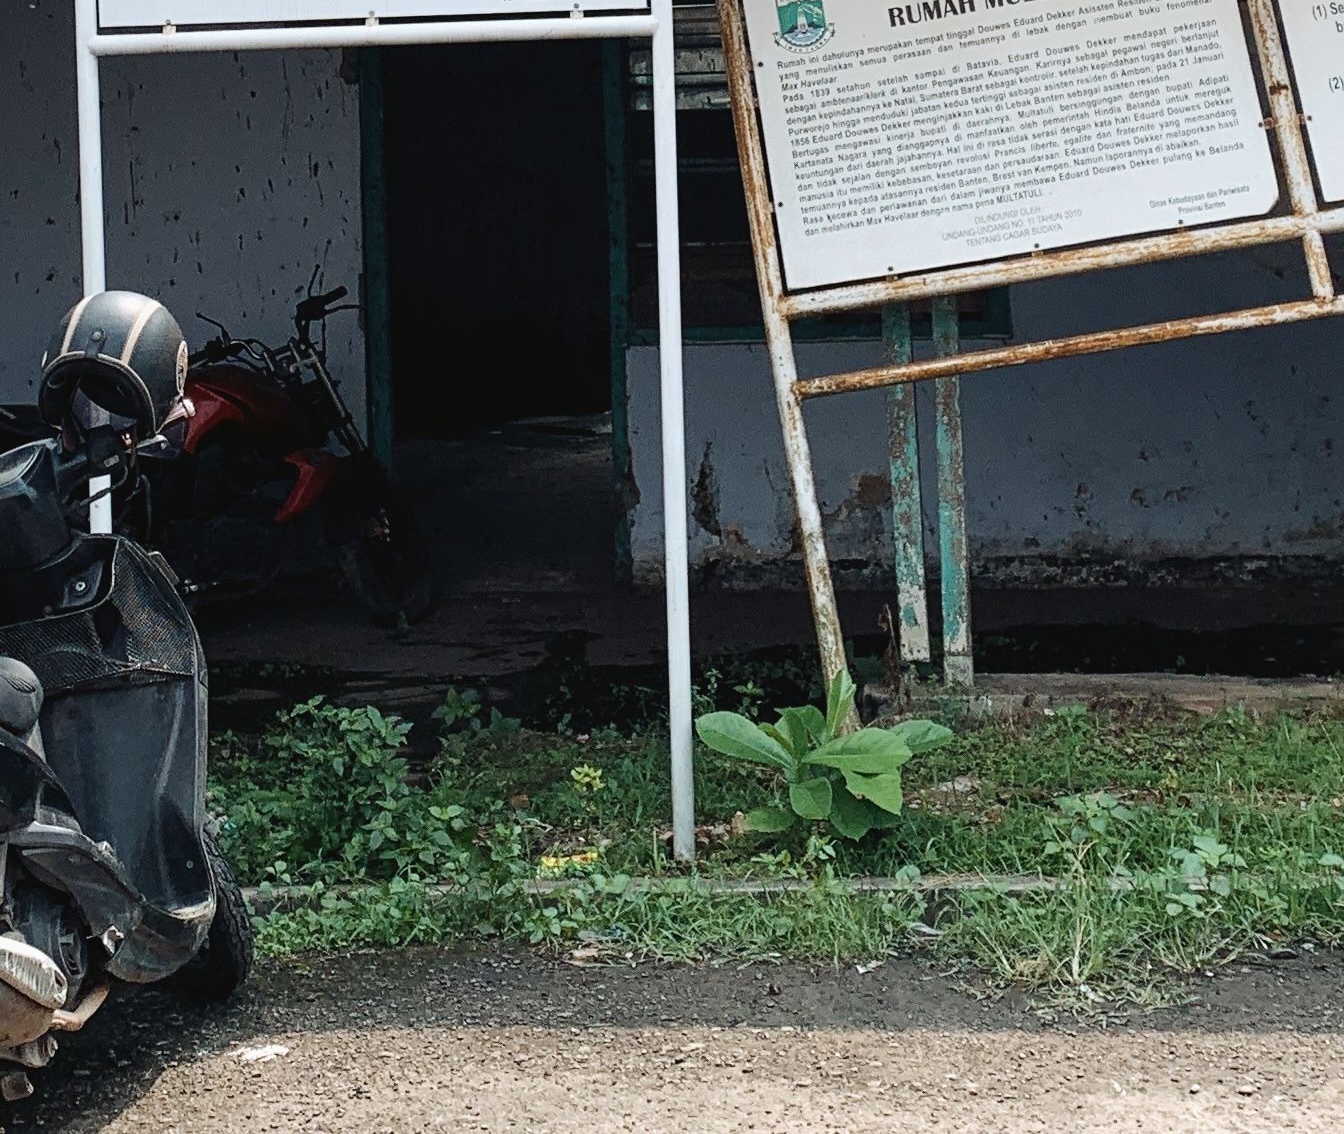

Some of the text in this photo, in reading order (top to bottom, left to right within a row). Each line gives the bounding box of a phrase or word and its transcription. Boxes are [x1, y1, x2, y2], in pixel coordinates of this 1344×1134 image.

[1311, 3, 1328, 22] (1)
[775, 56, 807, 70] Rumah
[807, 54, 820, 64] ini
[821, 48, 865, 62] dahulunya
[866, 39, 913, 55] merupakan
[914, 32, 945, 46] tempat
[945, 26, 976, 40] tinggal
[976, 21, 1011, 35] Douwes
[1012, 13, 1044, 28] Eduard
[1045, 9, 1076, 22] Dekker
[1327, 75, 1344, 93] (2)
